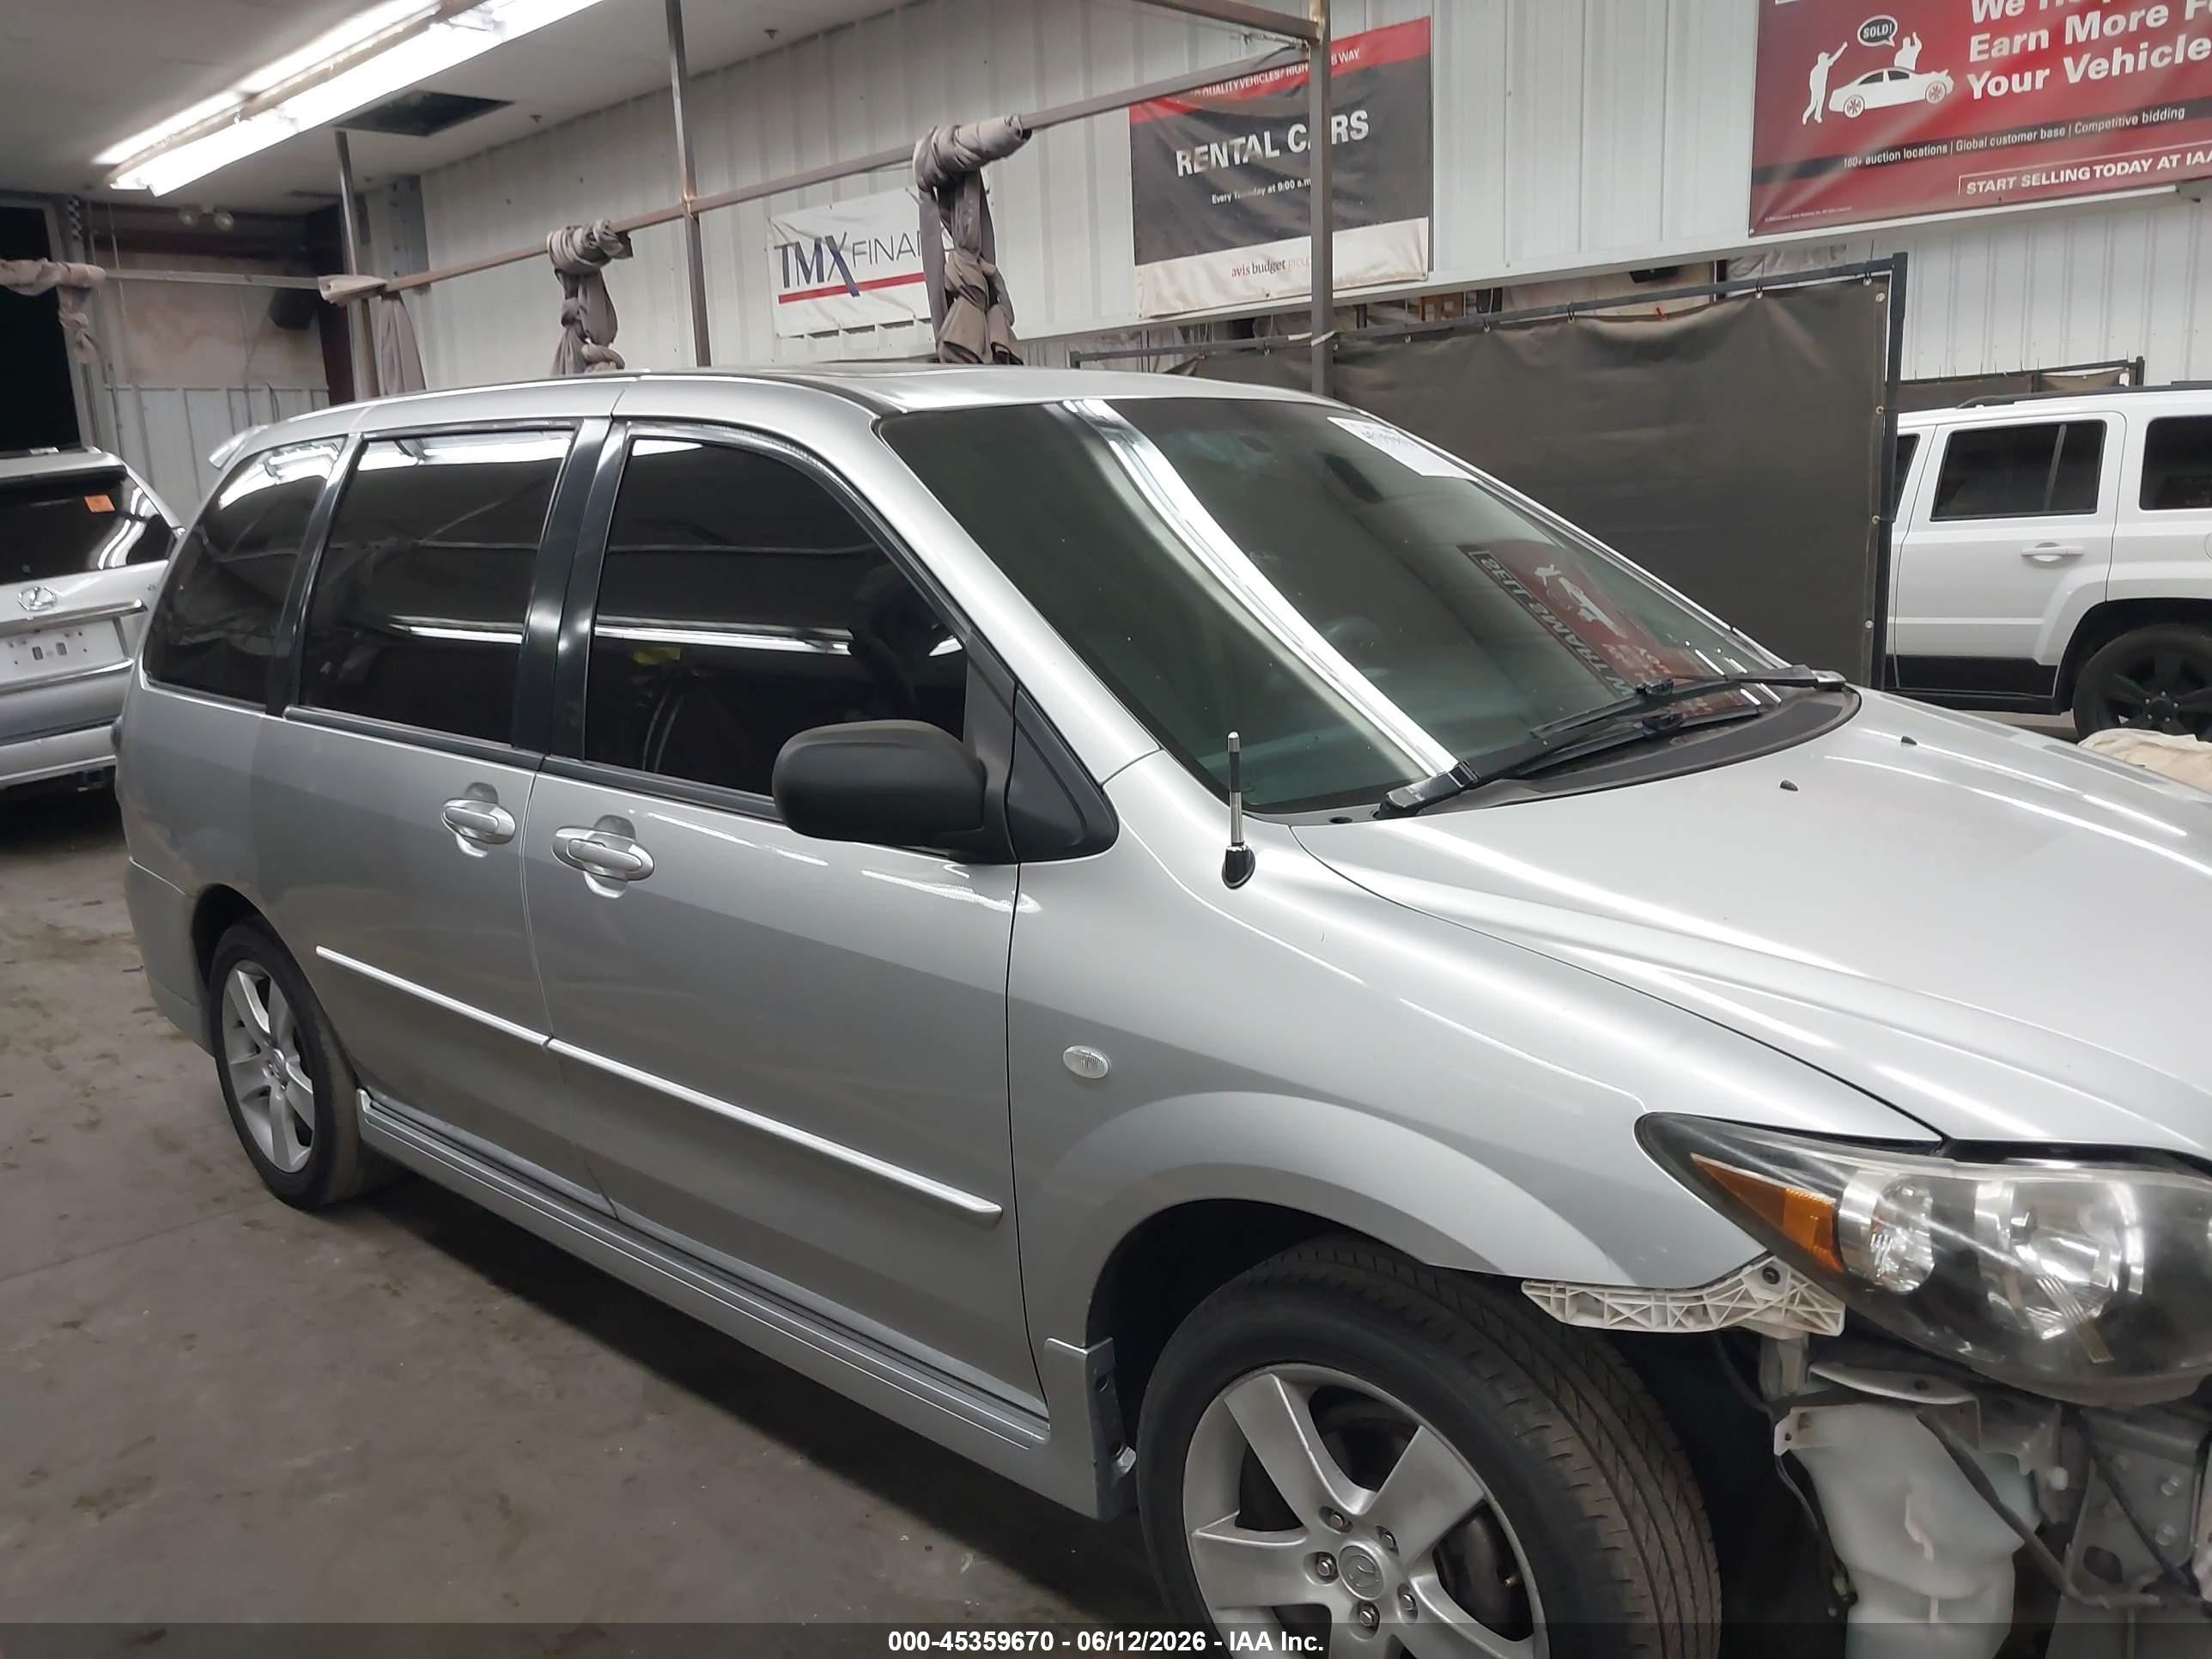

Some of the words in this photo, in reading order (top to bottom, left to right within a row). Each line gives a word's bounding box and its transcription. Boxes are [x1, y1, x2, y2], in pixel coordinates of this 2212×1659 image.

[1863, 22, 1893, 40] SOLD!
[1969, 28, 2050, 63] Earn
[2065, 4, 2169, 46] More
[1972, 0, 2025, 23] We
[1966, 68, 2051, 100] Your
[2063, 34, 2212, 84] Vehicle
[1176, 131, 1280, 177] RENTAL
[1288, 109, 1370, 154] CRS
[1864, 150, 1901, 166] auction
[1903, 143, 1948, 160] locations
[1956, 136, 1988, 153] Global
[1990, 130, 2038, 148] customer
[2040, 126, 2066, 140] base
[2074, 116, 2139, 136] Competitive
[2142, 107, 2185, 125] bidding
[1212, 192, 1232, 205] Every
[1267, 183, 1276, 194] at
[1966, 175, 2017, 196] START
[2021, 166, 2091, 188] SELLING
[2093, 157, 2154, 180] TODAY
[2156, 154, 2182, 170] AT
[774, 231, 860, 297] TMX
[1231, 263, 1250, 277] avis
[1252, 258, 1286, 275] budget
